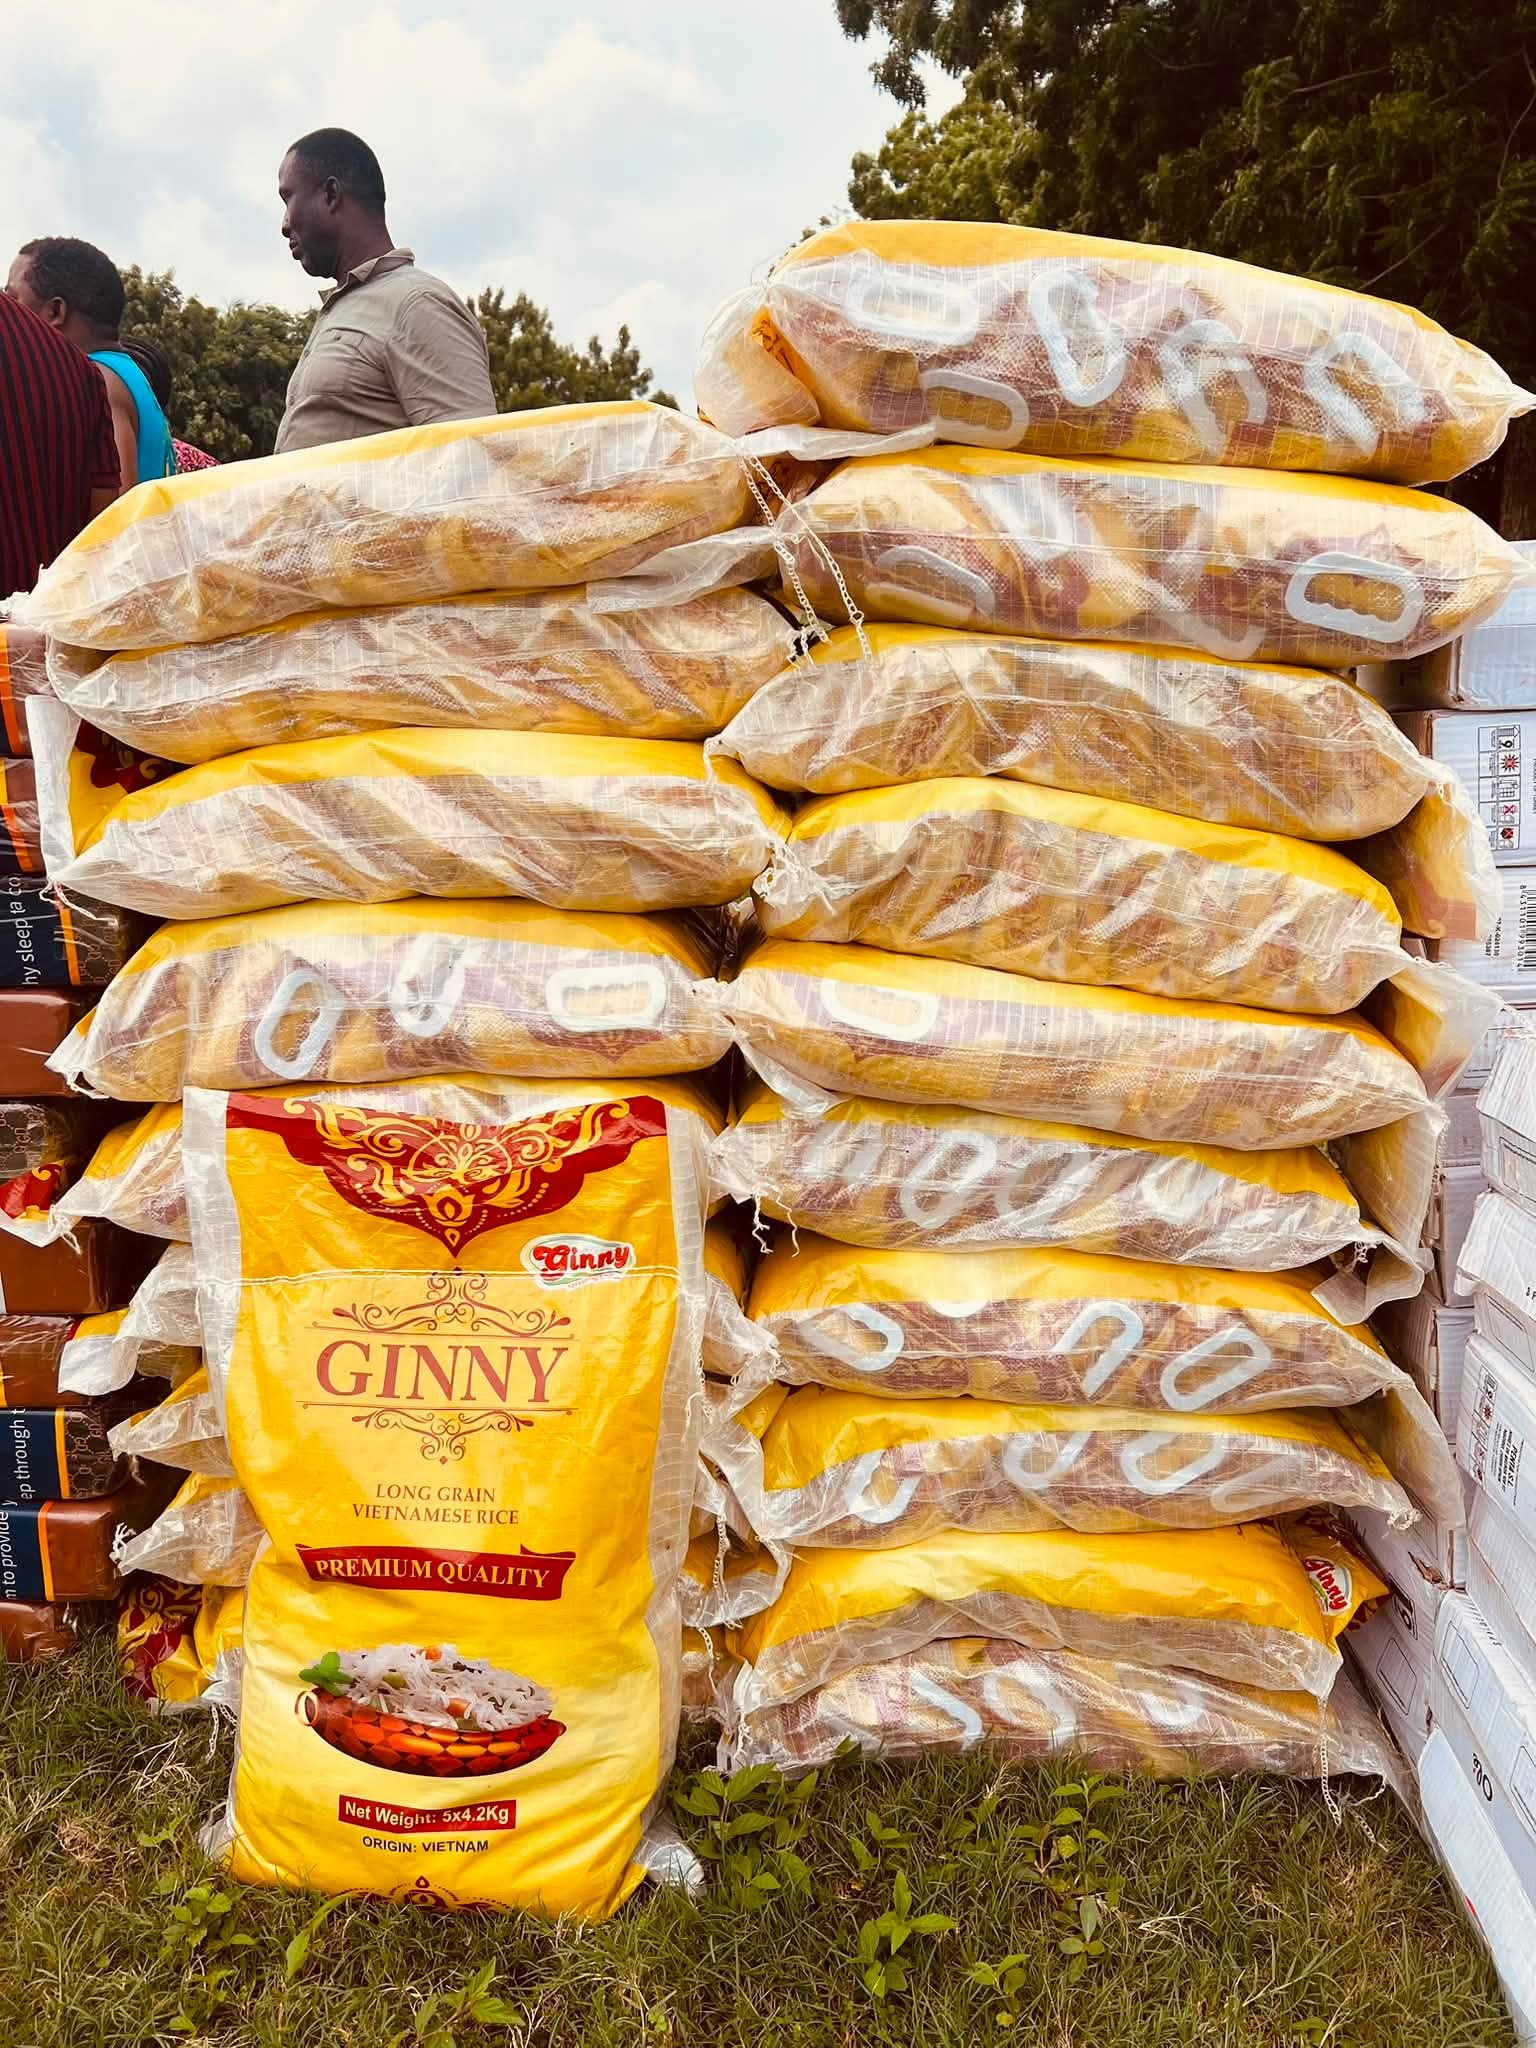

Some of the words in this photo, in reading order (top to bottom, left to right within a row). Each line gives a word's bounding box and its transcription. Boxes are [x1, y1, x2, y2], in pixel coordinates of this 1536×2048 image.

[15, 918, 34, 962] sleep
[532, 1241, 631, 1281] Ginny
[316, 1339, 569, 1403] GINNY
[9, 1418, 31, 1480] through
[375, 1482, 432, 1502] LONG
[436, 1484, 496, 1504] GRAIN
[352, 1502, 474, 1525] VIETNAMESE
[476, 1509, 519, 1526] RICE
[2, 1569, 16, 1587] to
[315, 1557, 434, 1581] PREMIUM
[437, 1559, 551, 1589] QUALITY
[344, 1801, 372, 1821] Net
[375, 1806, 437, 1830] Weight:
[442, 1804, 510, 1826] 5x4.2Kg
[362, 1836, 417, 1854] ORIGIN:
[421, 1839, 489, 1853] VIETNAM
